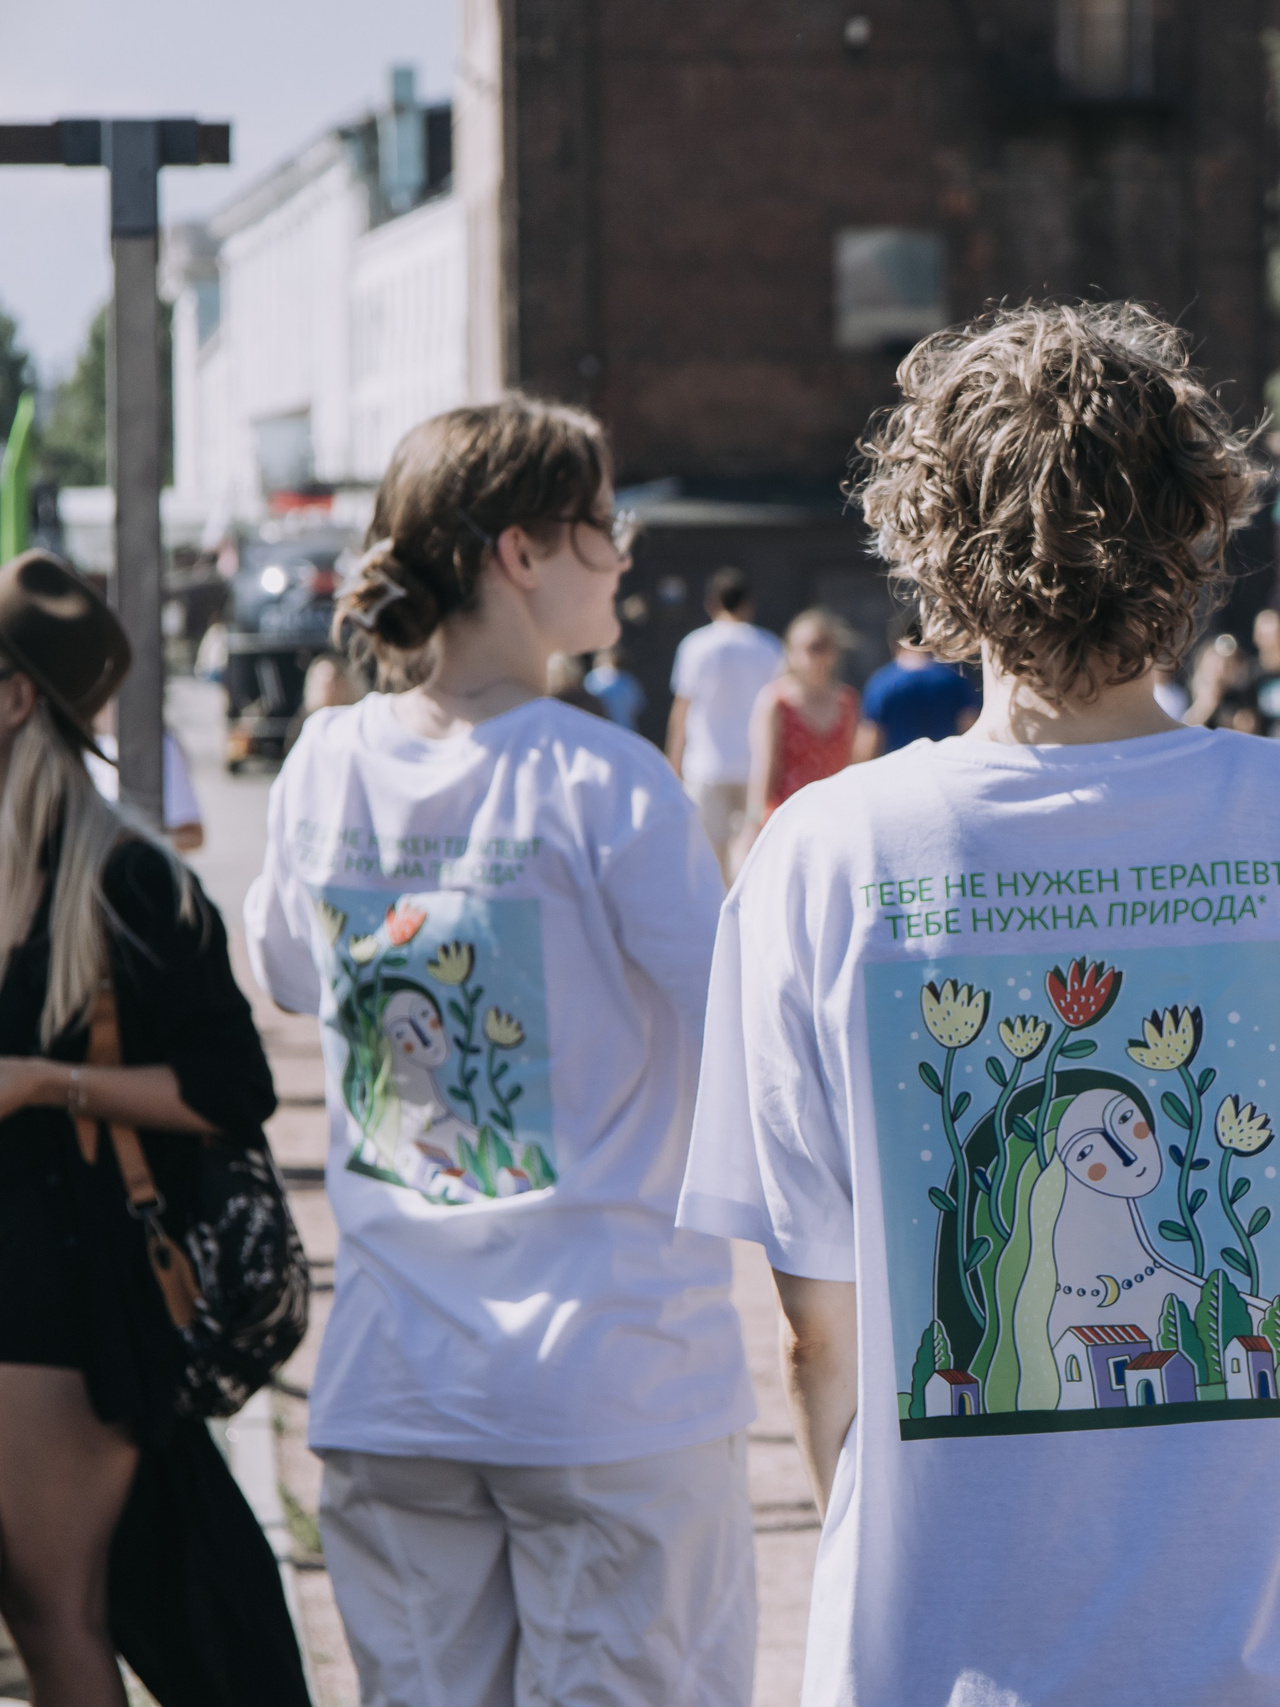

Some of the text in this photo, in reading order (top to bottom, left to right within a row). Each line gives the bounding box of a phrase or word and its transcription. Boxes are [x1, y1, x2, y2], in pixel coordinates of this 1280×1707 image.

[859, 877, 935, 907] ТЕБЕ
[944, 872, 987, 899] НЕ
[997, 868, 1119, 897] НУЖЕН
[884, 907, 962, 940] ТЕБЕ
[971, 903, 1099, 933] НУЖНА
